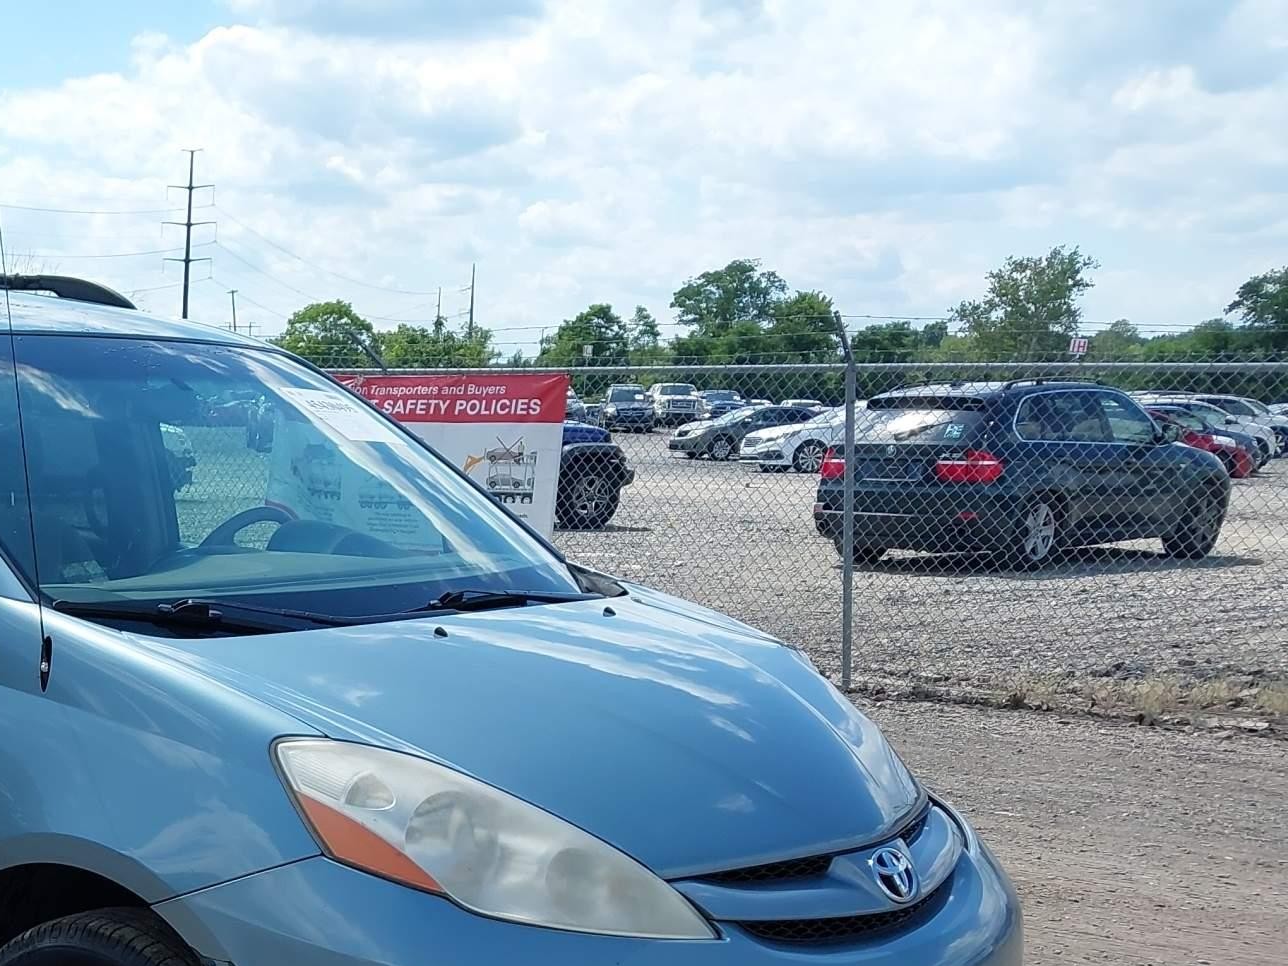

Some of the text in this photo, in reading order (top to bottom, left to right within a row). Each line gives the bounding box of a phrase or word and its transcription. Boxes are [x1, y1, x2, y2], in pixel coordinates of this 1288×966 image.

[370, 385, 439, 397] Transporters
[441, 384, 465, 395] and
[467, 384, 507, 397] Buyers
[382, 399, 451, 415] SAFETY
[454, 399, 542, 416] POLICIES
